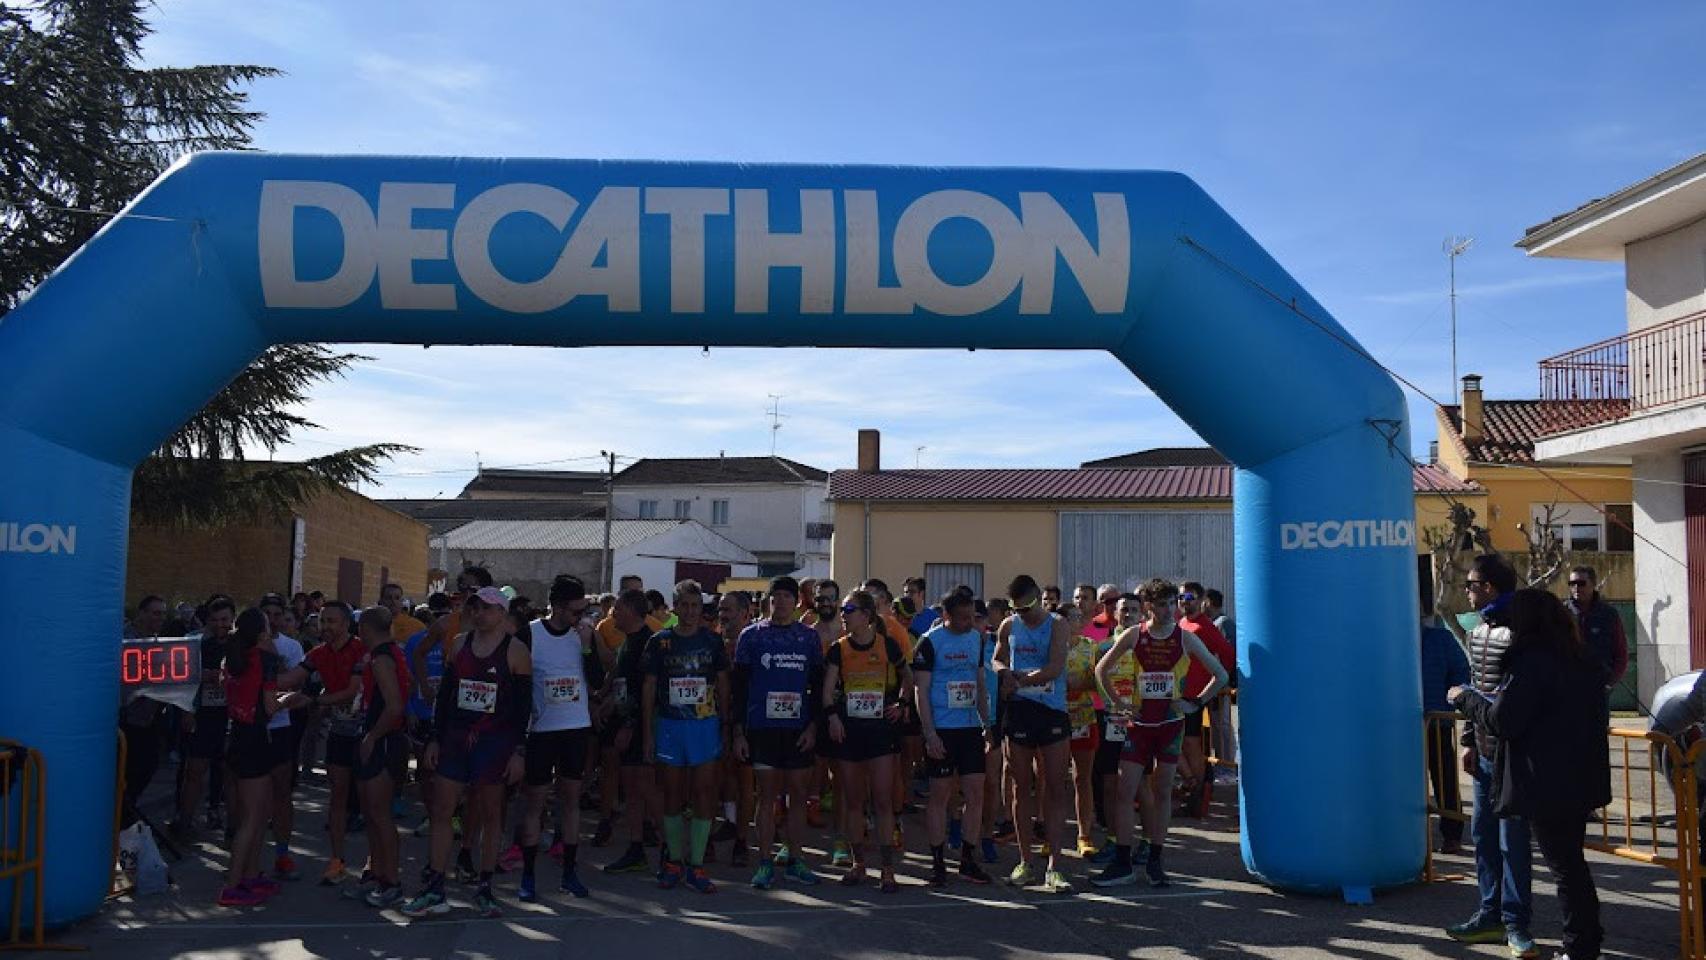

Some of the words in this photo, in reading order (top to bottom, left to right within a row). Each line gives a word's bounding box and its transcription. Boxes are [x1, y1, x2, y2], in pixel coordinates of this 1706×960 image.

[257, 179, 1132, 316] DECATHLON
[678, 687, 698, 698] 135
[1145, 682, 1166, 693] 208
[774, 702, 793, 712] 254
